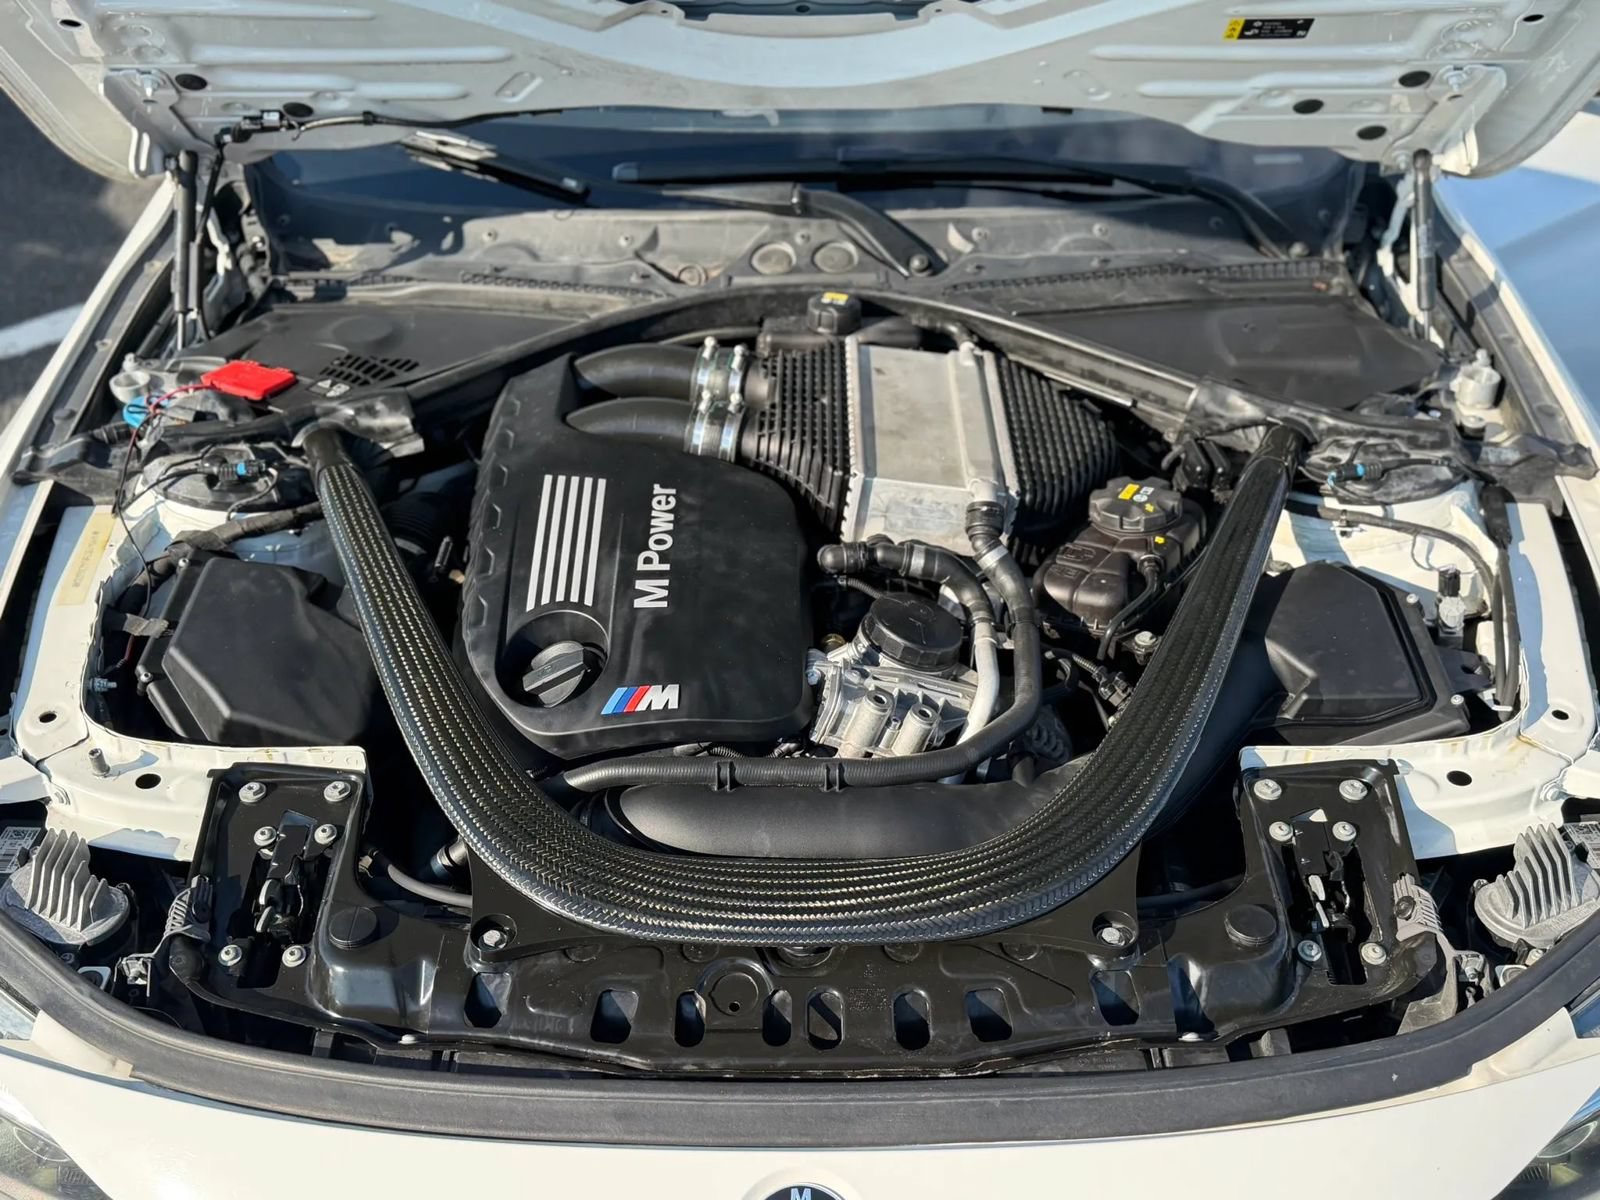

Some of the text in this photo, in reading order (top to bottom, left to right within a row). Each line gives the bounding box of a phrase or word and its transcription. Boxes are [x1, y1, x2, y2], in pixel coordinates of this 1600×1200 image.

[633, 484, 677, 608] M Power
[635, 684, 680, 711] M
